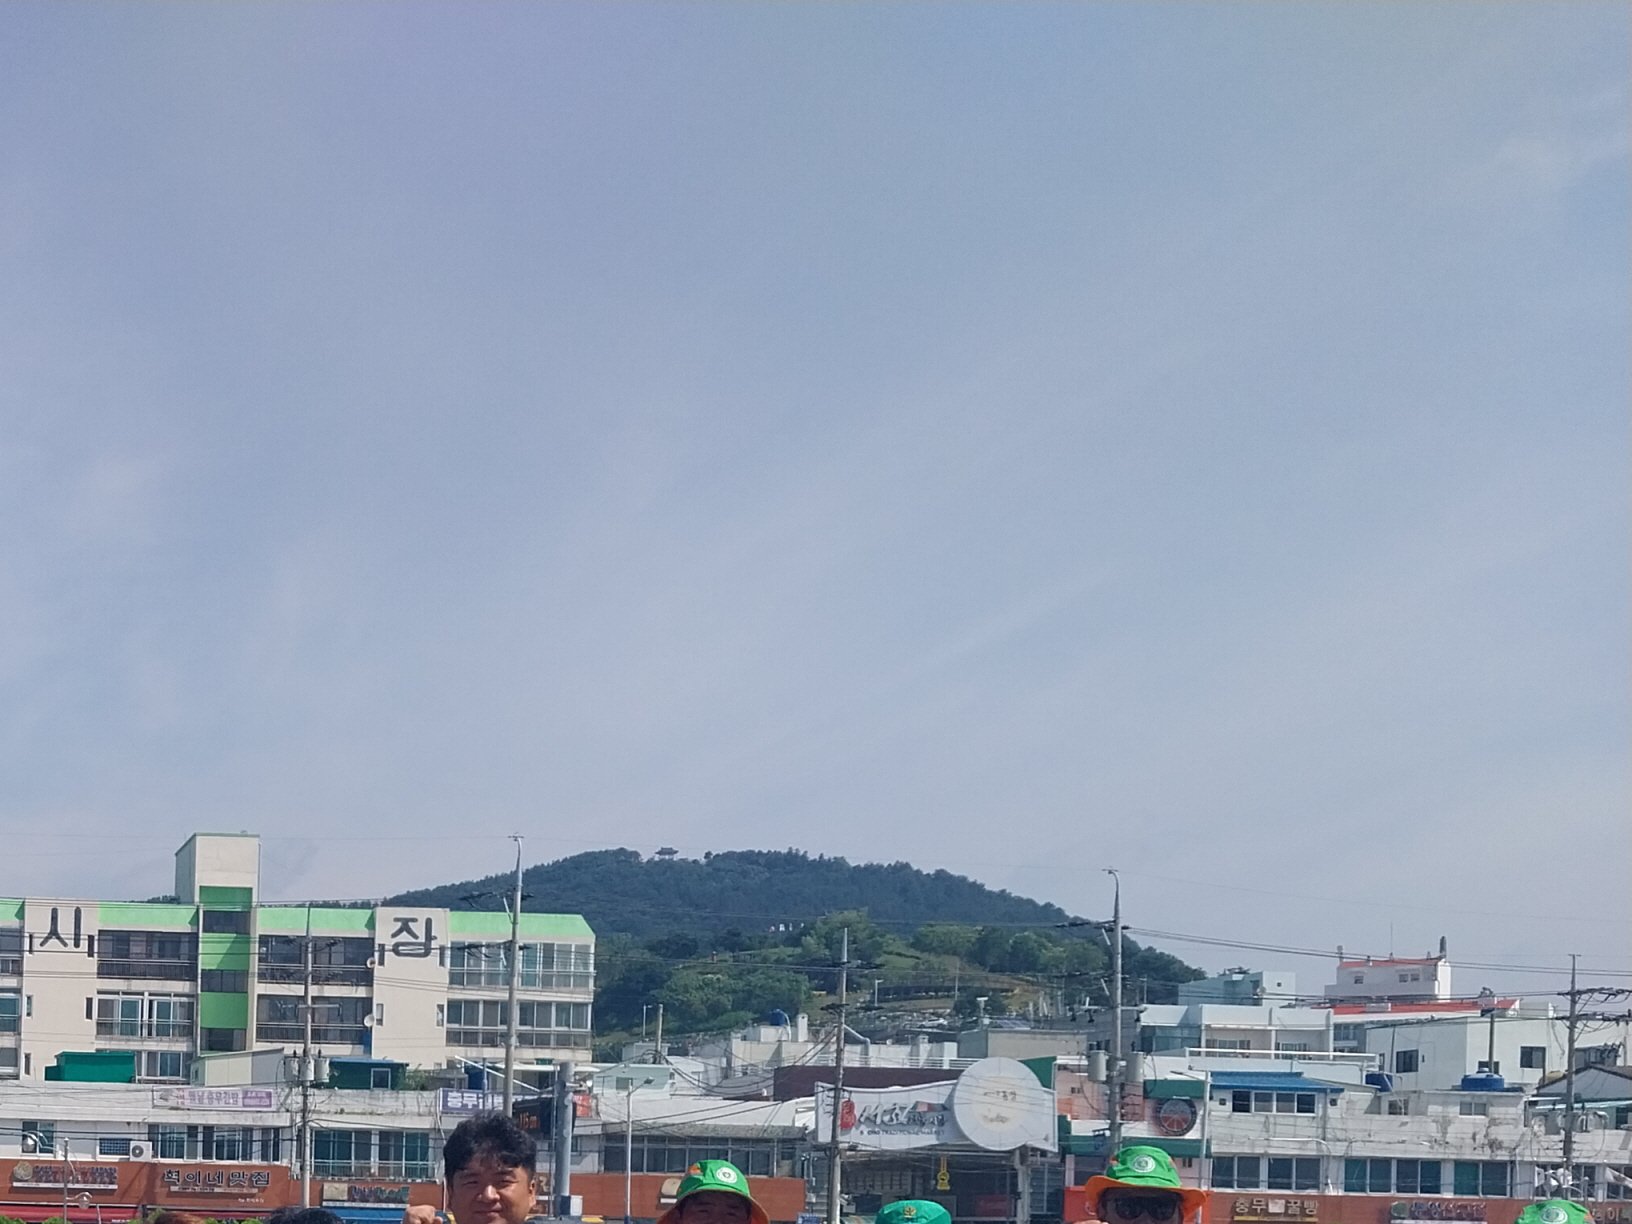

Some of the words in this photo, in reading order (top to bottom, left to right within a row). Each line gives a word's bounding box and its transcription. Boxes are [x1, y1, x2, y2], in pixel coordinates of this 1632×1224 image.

[39, 906, 82, 949] 시
[390, 917, 438, 958] 장
[1236, 1197, 1267, 1214] 충무
[1287, 1199, 1319, 1215] 꿀빵
